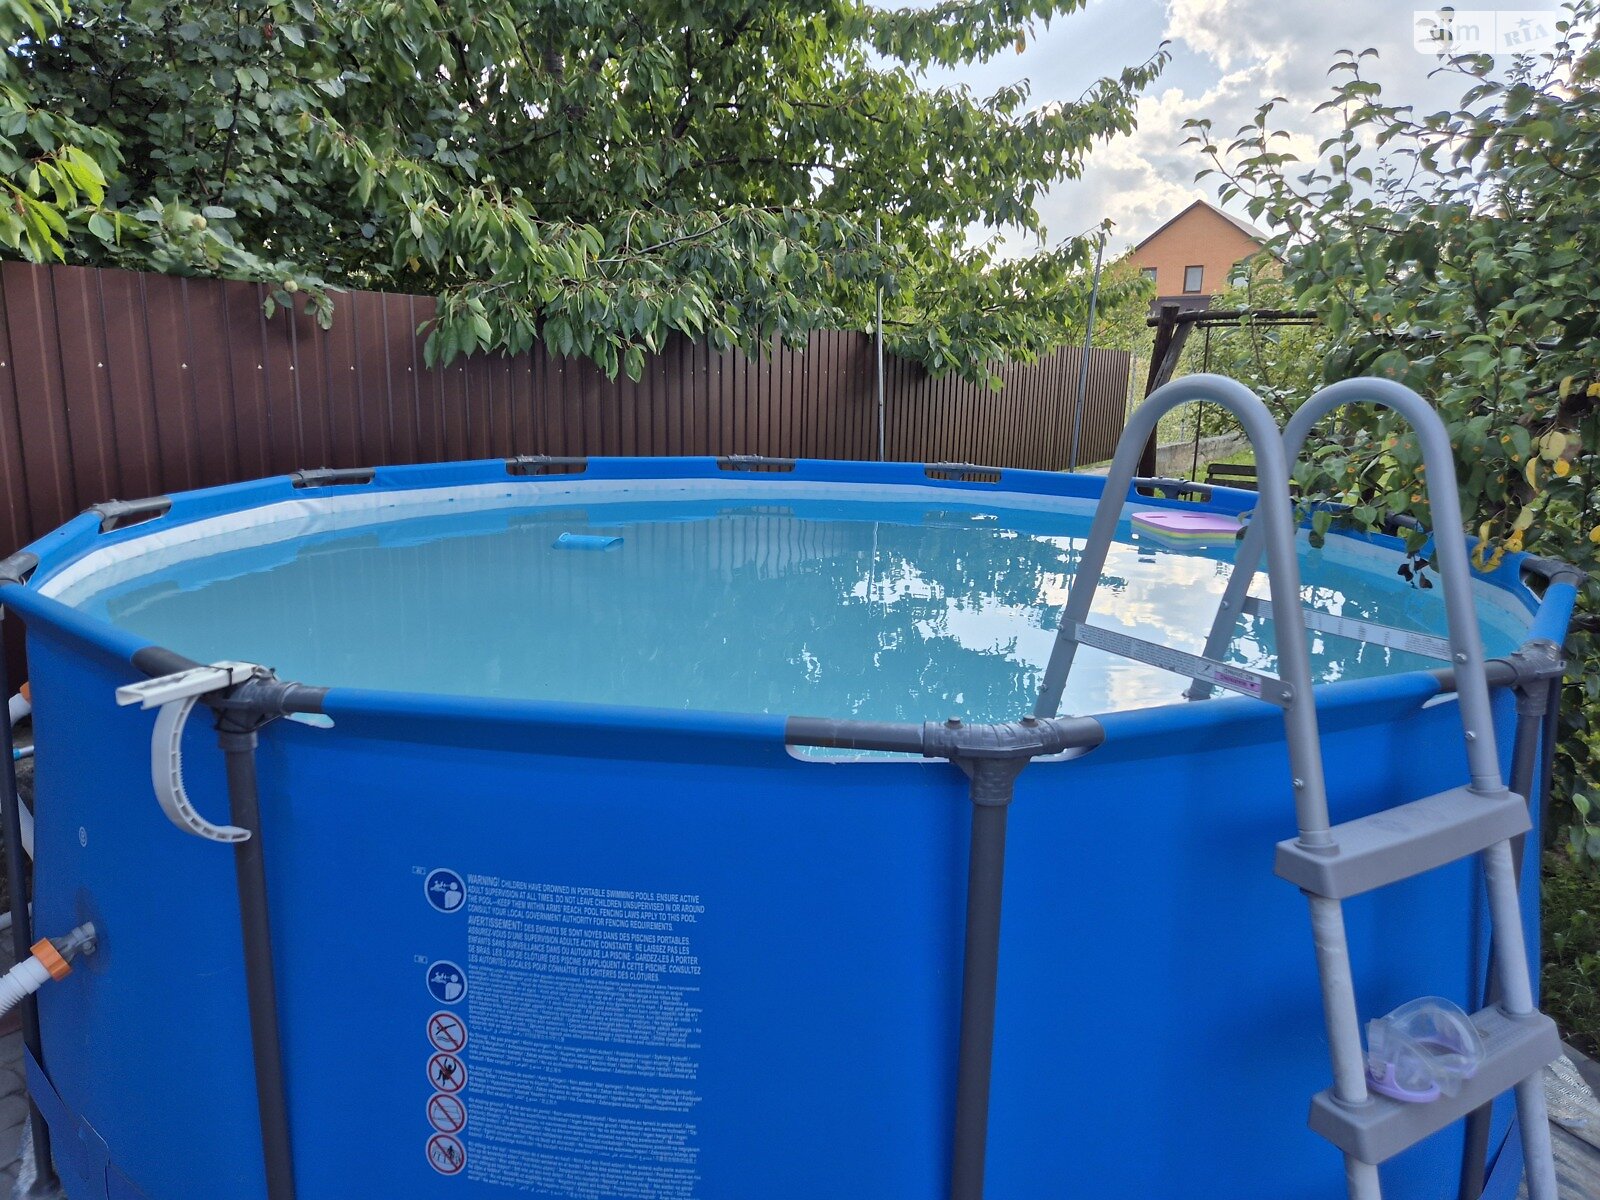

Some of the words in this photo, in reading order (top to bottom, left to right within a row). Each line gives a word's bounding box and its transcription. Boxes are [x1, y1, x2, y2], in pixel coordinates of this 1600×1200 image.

[577, 887, 605, 897] PORTABLE
[656, 893, 678, 902] ENSURE
[680, 895, 699, 904] ACTIVE
[594, 898, 621, 908] CHILDREN
[681, 904, 705, 913] AROUND
[584, 907, 598, 916] POOL
[640, 912, 658, 920] APPLY
[593, 917, 604, 926] FOR
[667, 946, 678, 954] PAS
[679, 946, 689, 955] LES
